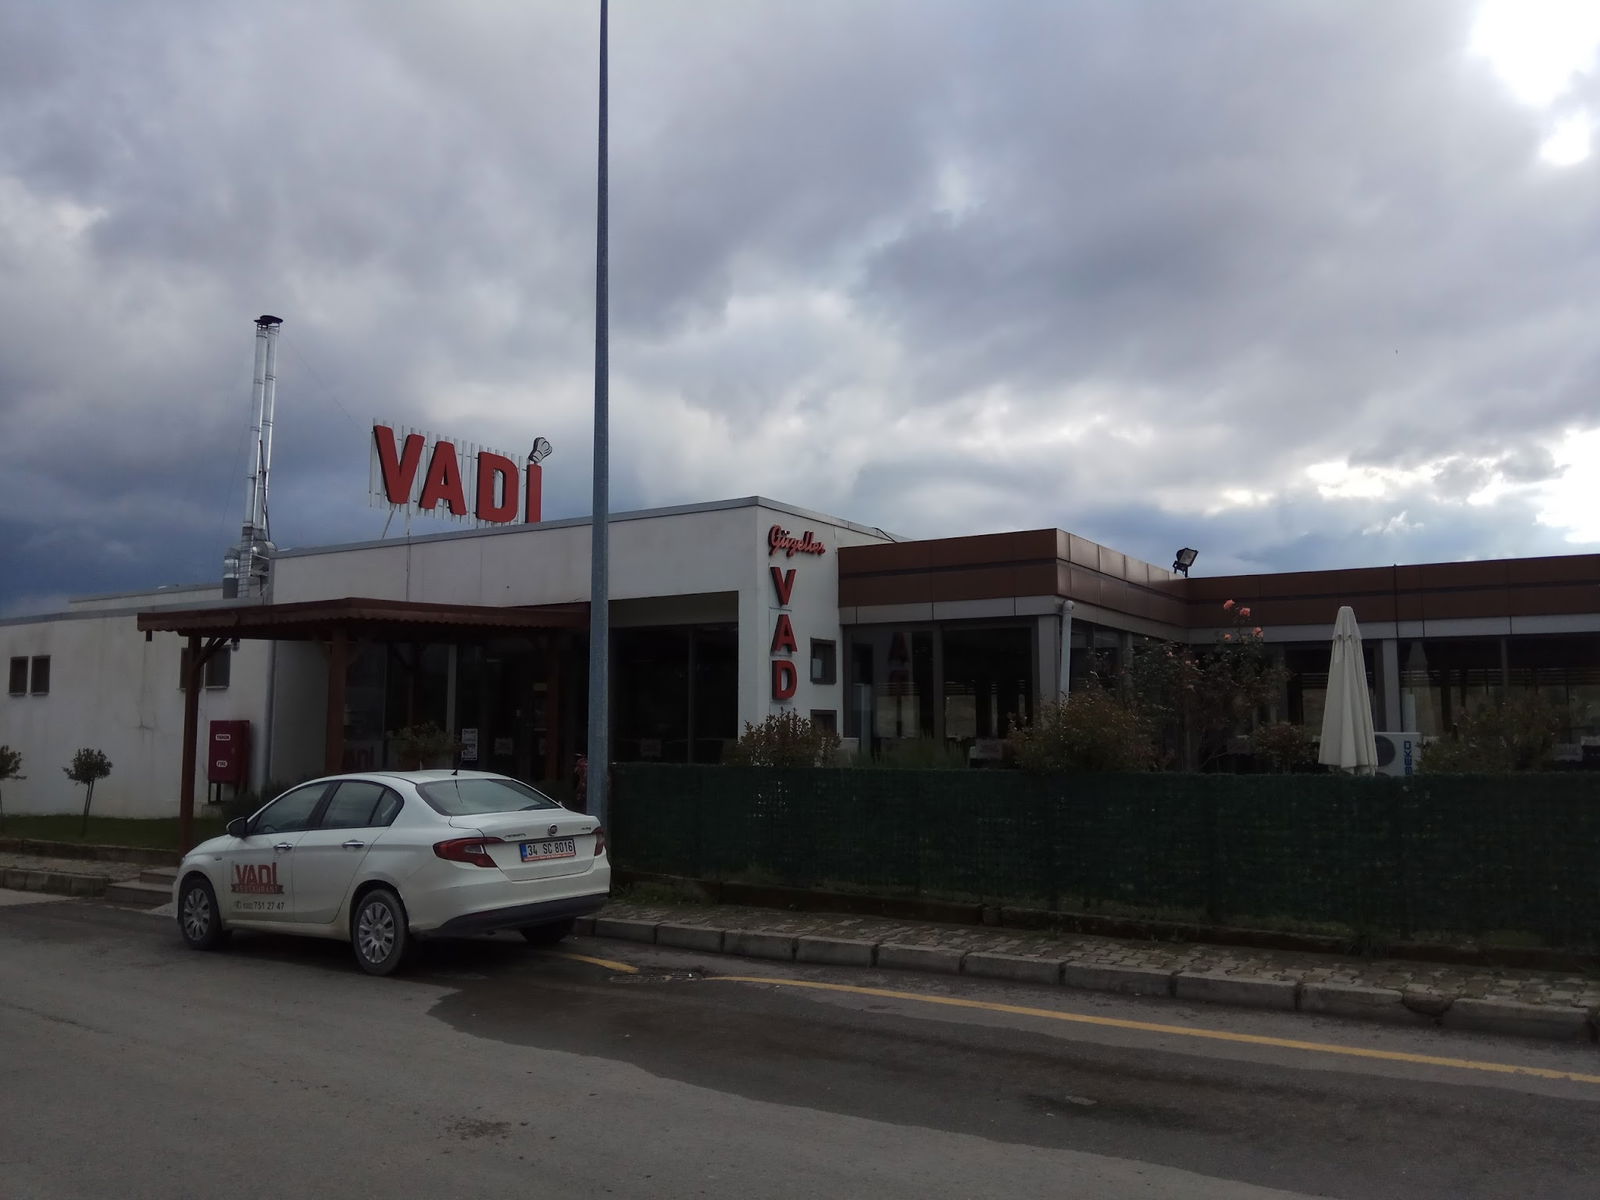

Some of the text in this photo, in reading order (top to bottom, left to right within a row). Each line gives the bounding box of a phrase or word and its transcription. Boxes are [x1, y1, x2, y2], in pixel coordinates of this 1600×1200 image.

[1404, 741, 1412, 775] BEKO
[527, 841, 573, 856] 34 SC 8016
